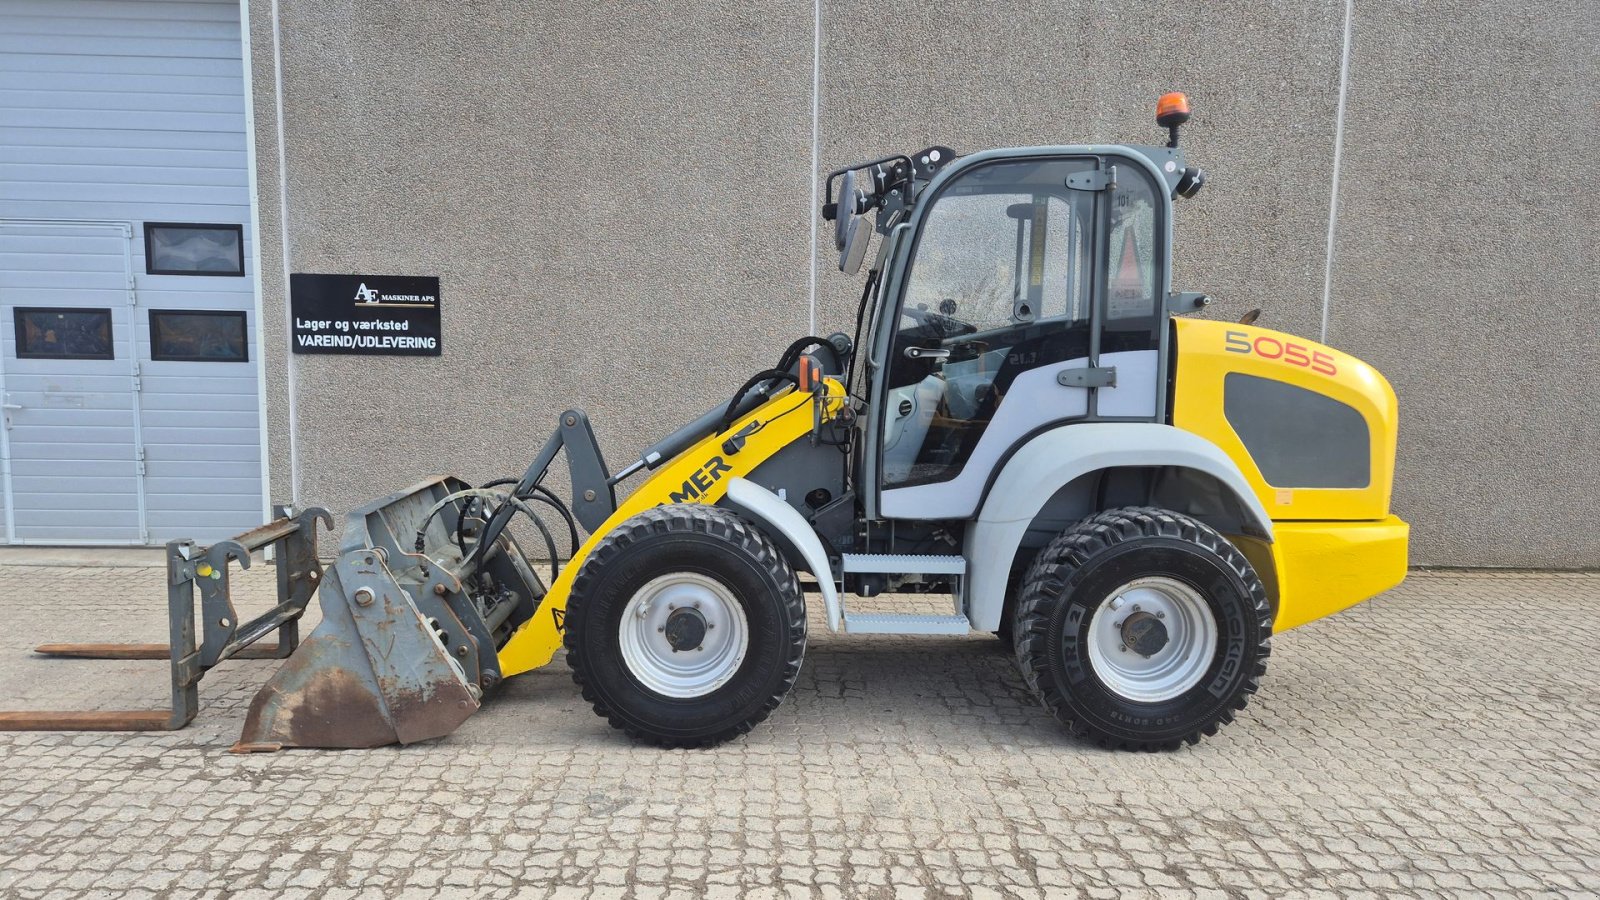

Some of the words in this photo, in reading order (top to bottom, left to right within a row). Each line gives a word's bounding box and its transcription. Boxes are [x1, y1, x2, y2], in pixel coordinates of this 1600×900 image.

[381, 294, 420, 302] MASKINER
[296, 318, 332, 331] Lager
[335, 320, 349, 332] og
[352, 319, 409, 331] værksted
[297, 334, 436, 349] VAREIND/UDLEVERING
[1225, 330, 1337, 376] 5055
[656, 456, 733, 506] MER
